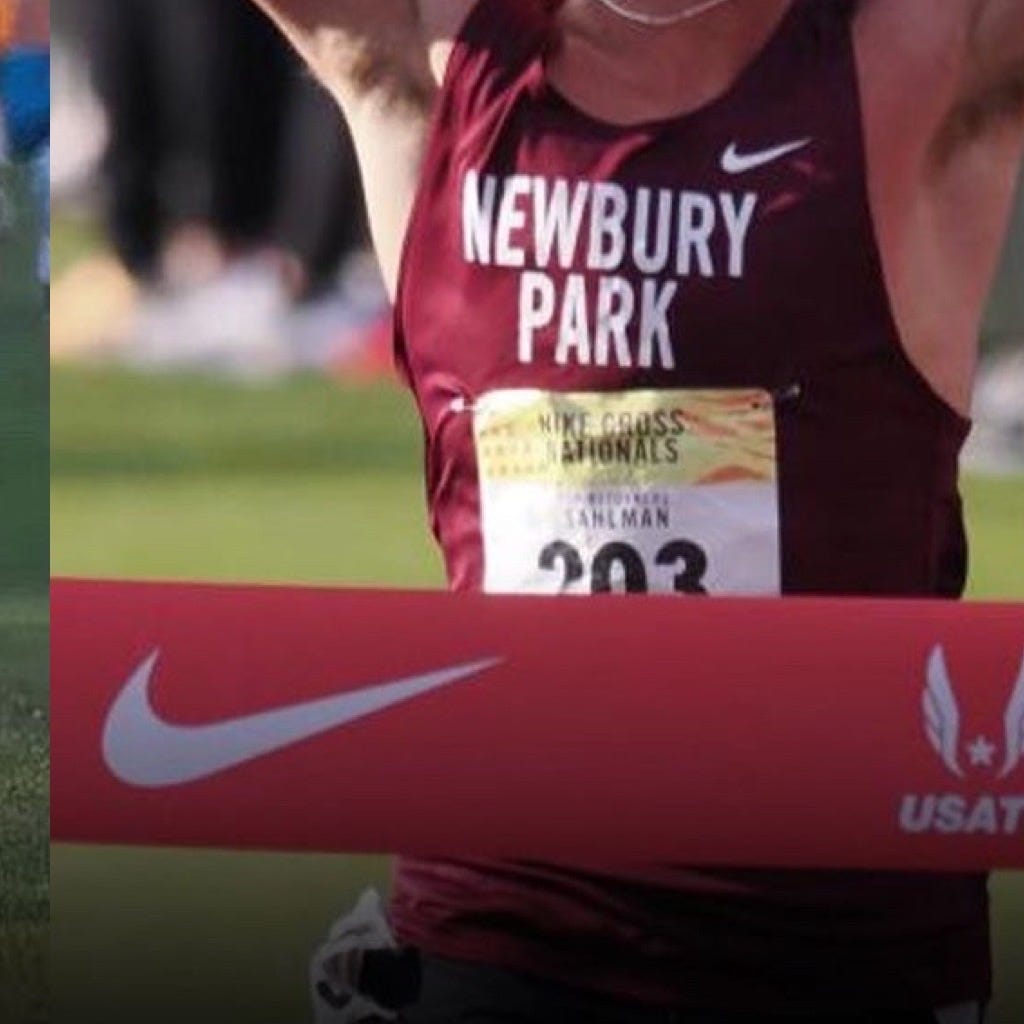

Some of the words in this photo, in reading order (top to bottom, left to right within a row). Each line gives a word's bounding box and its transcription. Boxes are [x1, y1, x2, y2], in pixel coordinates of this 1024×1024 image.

[461, 169, 758, 278] NEWBURY
[517, 270, 678, 370] PARK
[538, 411, 590, 436] NIKE
[600, 408, 686, 437] CROSS
[546, 438, 680, 466] NATIONALS
[538, 538, 710, 596] 203
